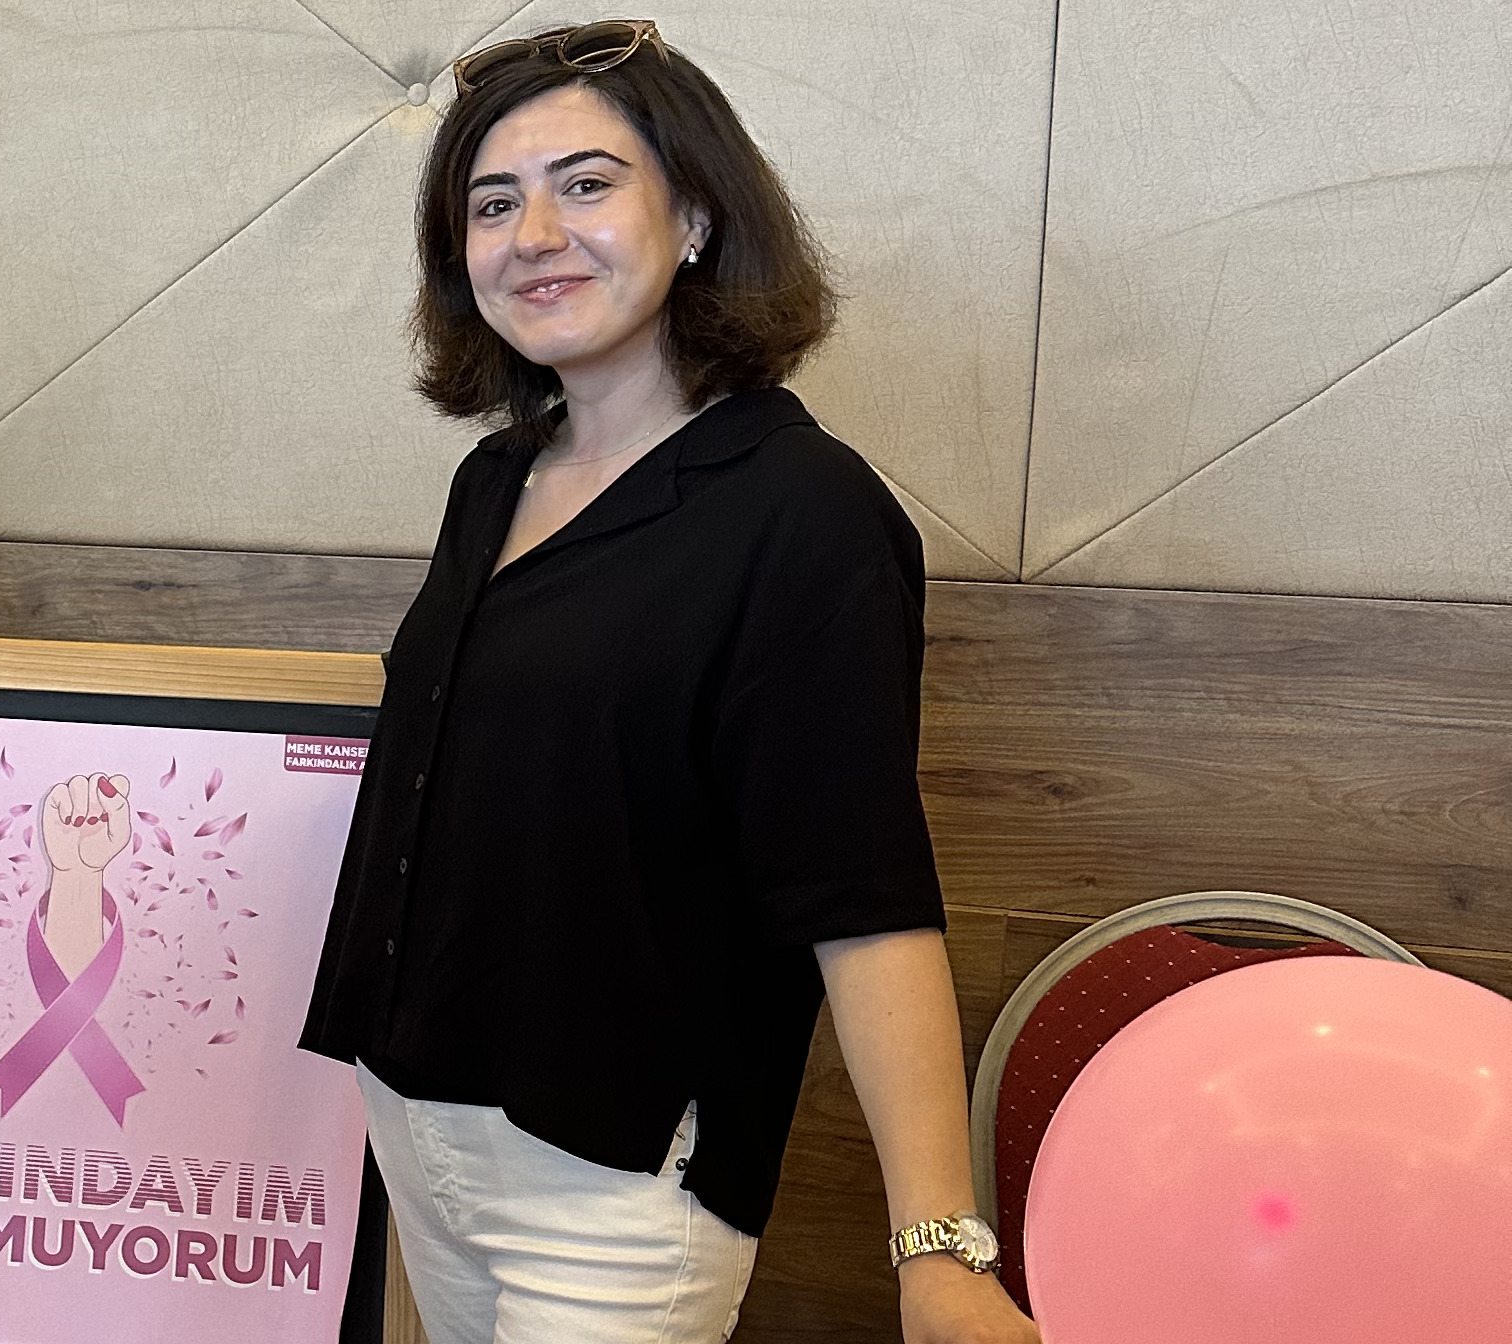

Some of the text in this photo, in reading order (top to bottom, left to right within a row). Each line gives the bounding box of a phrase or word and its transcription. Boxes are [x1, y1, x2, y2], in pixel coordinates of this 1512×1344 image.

[287, 743, 369, 758] MEME KANSE
[286, 757, 356, 771] FARKINDALIK
